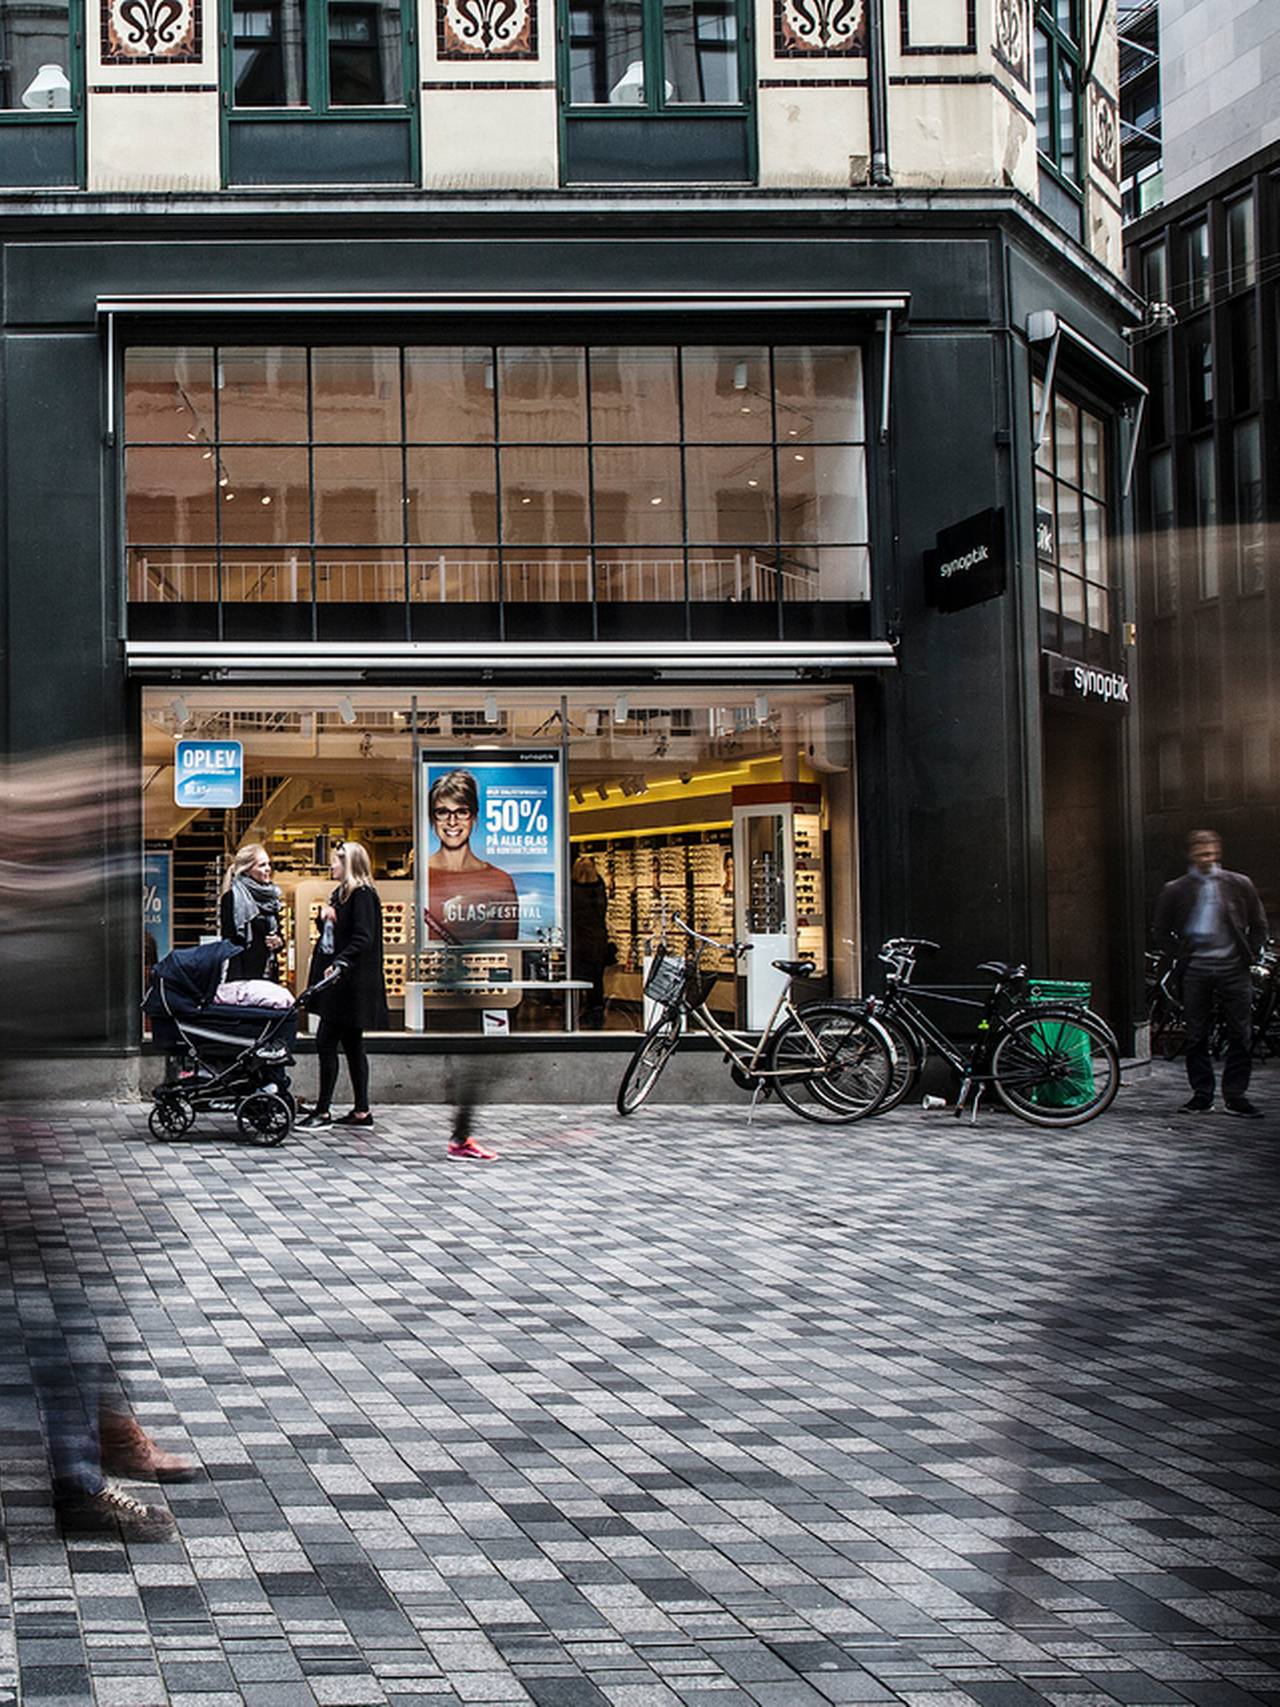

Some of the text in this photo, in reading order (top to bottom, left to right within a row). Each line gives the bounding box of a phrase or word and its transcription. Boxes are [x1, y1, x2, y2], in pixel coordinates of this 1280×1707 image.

[940, 545, 989, 578] synoptik
[1074, 666, 1129, 703] synoptik
[183, 749, 236, 768] OPLEV
[486, 799, 548, 833] 50%
[486, 832, 548, 847] PÅ ALLE GLAS
[447, 903, 487, 921] GLAS
